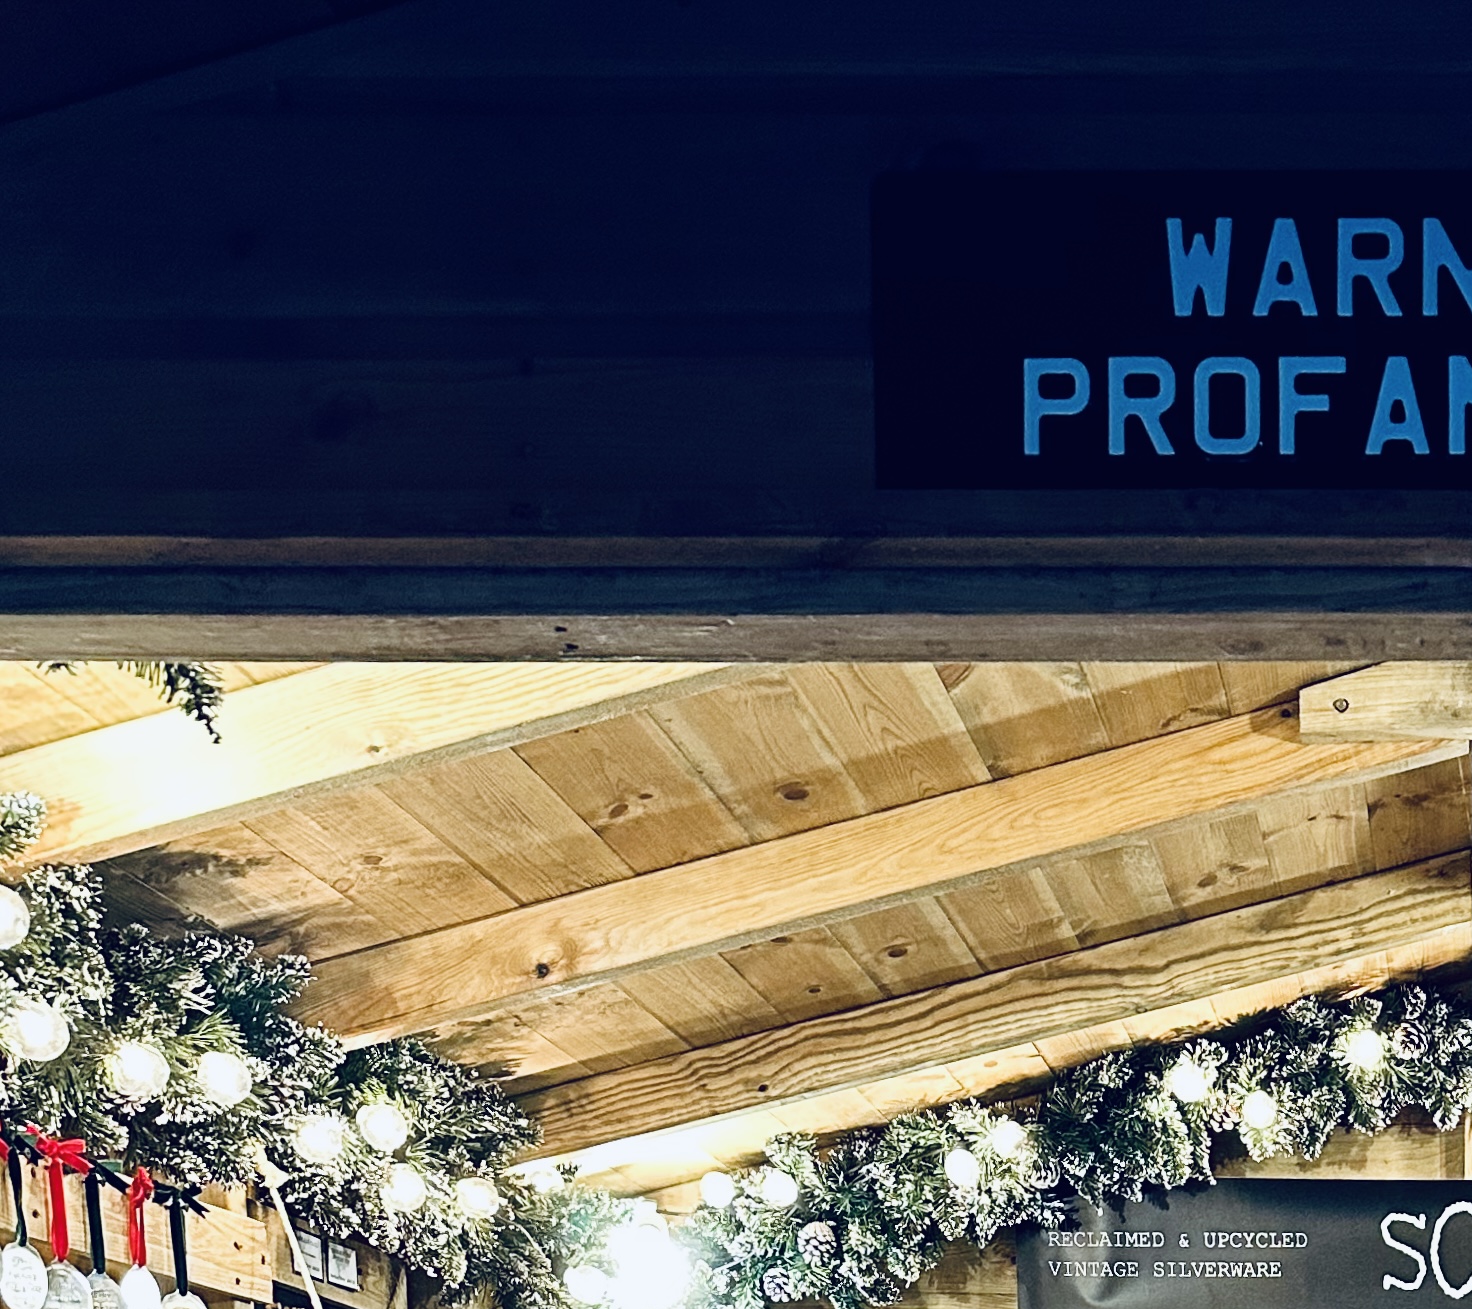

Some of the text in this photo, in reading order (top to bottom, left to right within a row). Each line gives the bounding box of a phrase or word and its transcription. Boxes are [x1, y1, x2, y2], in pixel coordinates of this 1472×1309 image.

[1047, 1231, 1308, 1249] RECLAIMED & UPCYCLED
[1048, 1261, 1282, 1279] VINTAGE SILVERWARE
